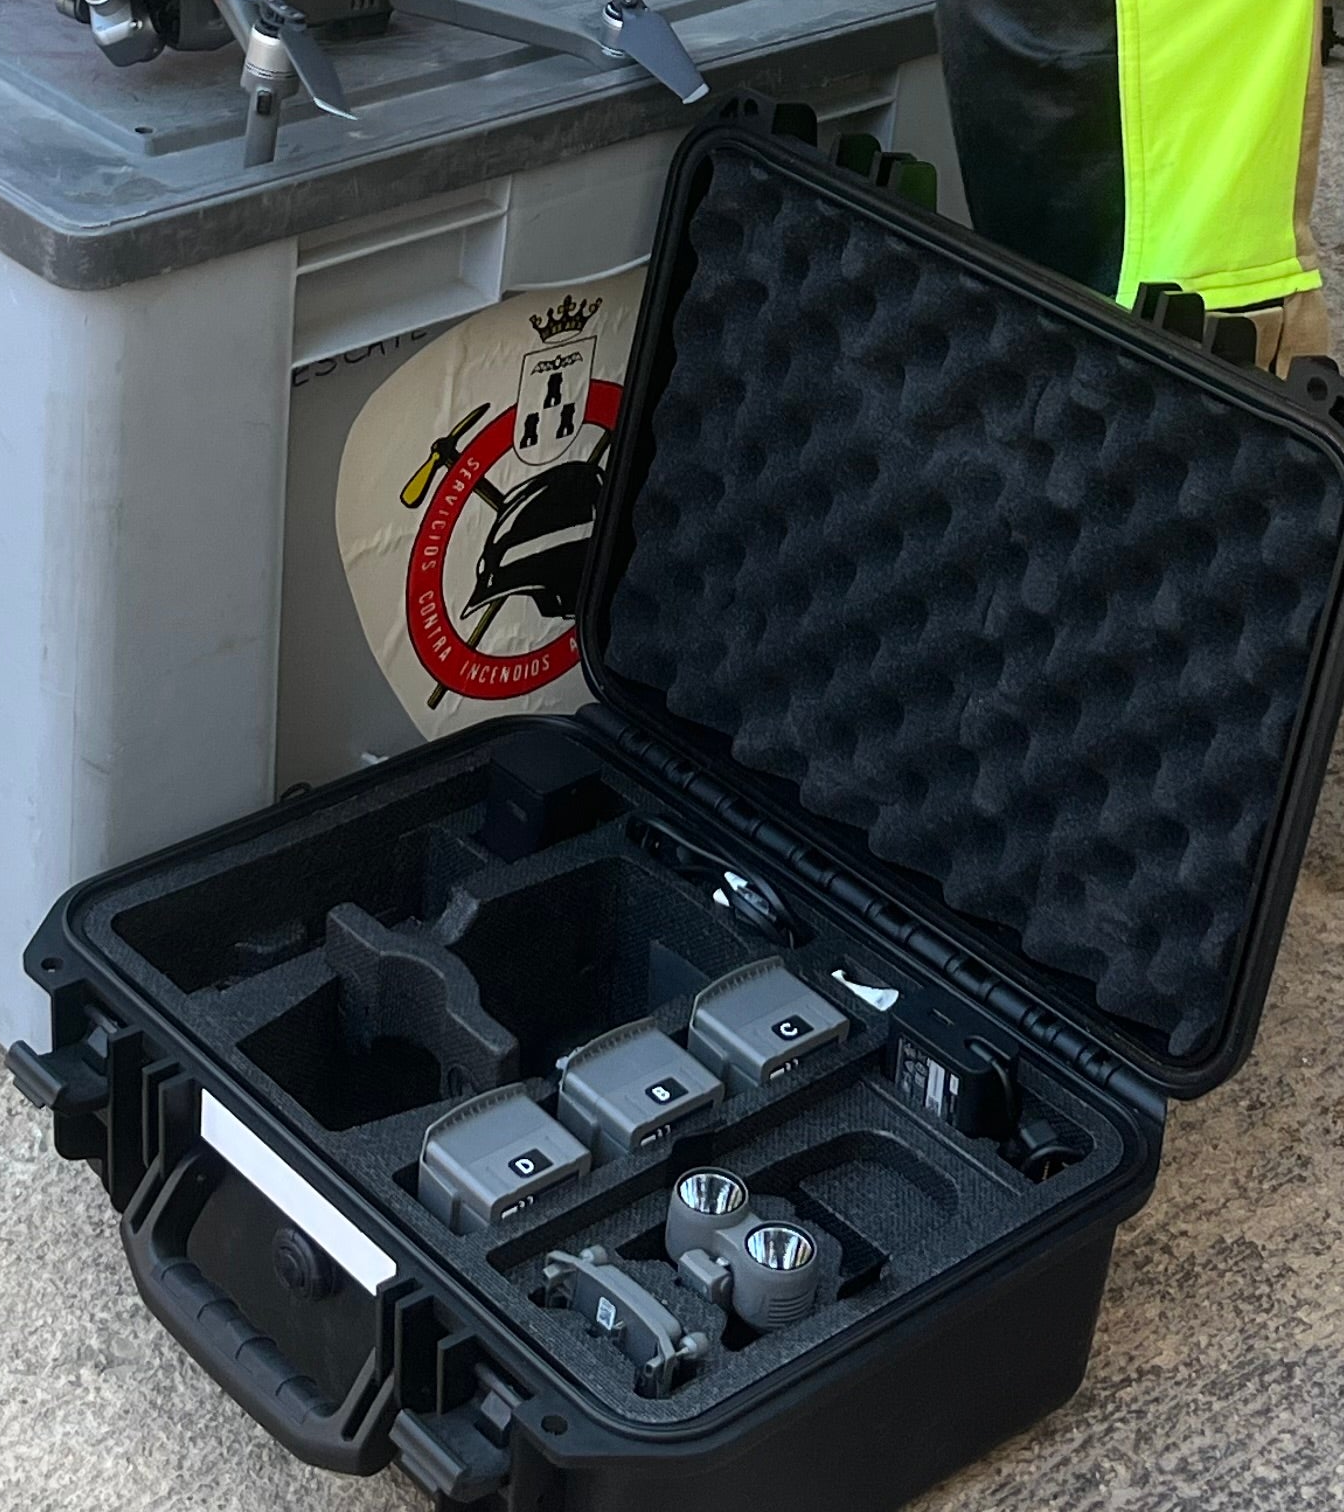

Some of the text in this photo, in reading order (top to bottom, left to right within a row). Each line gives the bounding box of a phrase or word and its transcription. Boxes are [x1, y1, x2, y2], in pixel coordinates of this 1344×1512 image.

[421, 457, 480, 571] SERVICIOS
[418, 591, 453, 662] CONTRA
[460, 654, 550, 684] INCENDIOS
[779, 1022, 798, 1036] C
[651, 1085, 670, 1102] B
[514, 1158, 535, 1174] D
